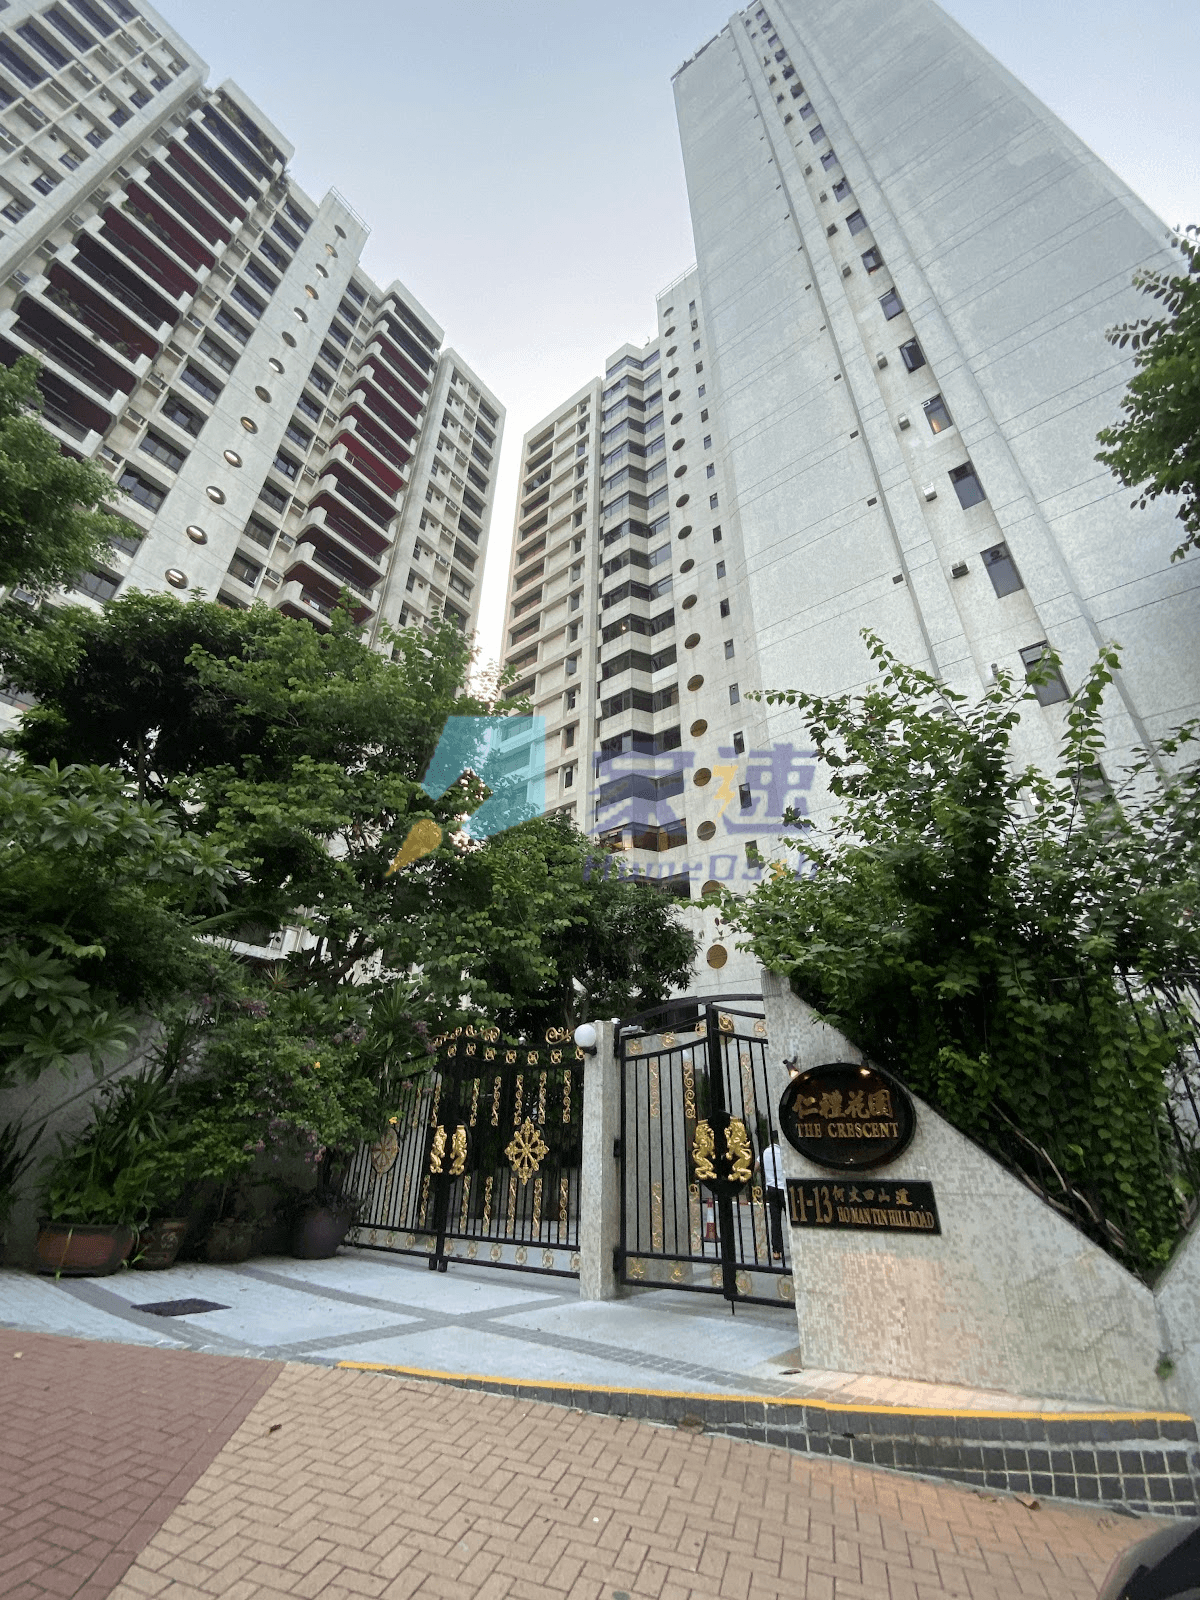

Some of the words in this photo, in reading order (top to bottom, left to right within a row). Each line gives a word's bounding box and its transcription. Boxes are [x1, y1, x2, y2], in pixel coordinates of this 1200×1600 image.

[795, 1122, 822, 1138] THE
[827, 1122, 899, 1138] CRESCENT
[789, 1185, 833, 1224] 11-13
[833, 1185, 913, 1206] 何文田山道
[836, 1206, 851, 1223] HO
[850, 1207, 872, 1225] MAN
[871, 1208, 889, 1226] TIN
[888, 1209, 911, 1227] HILL
[909, 1210, 935, 1229] ROAD
